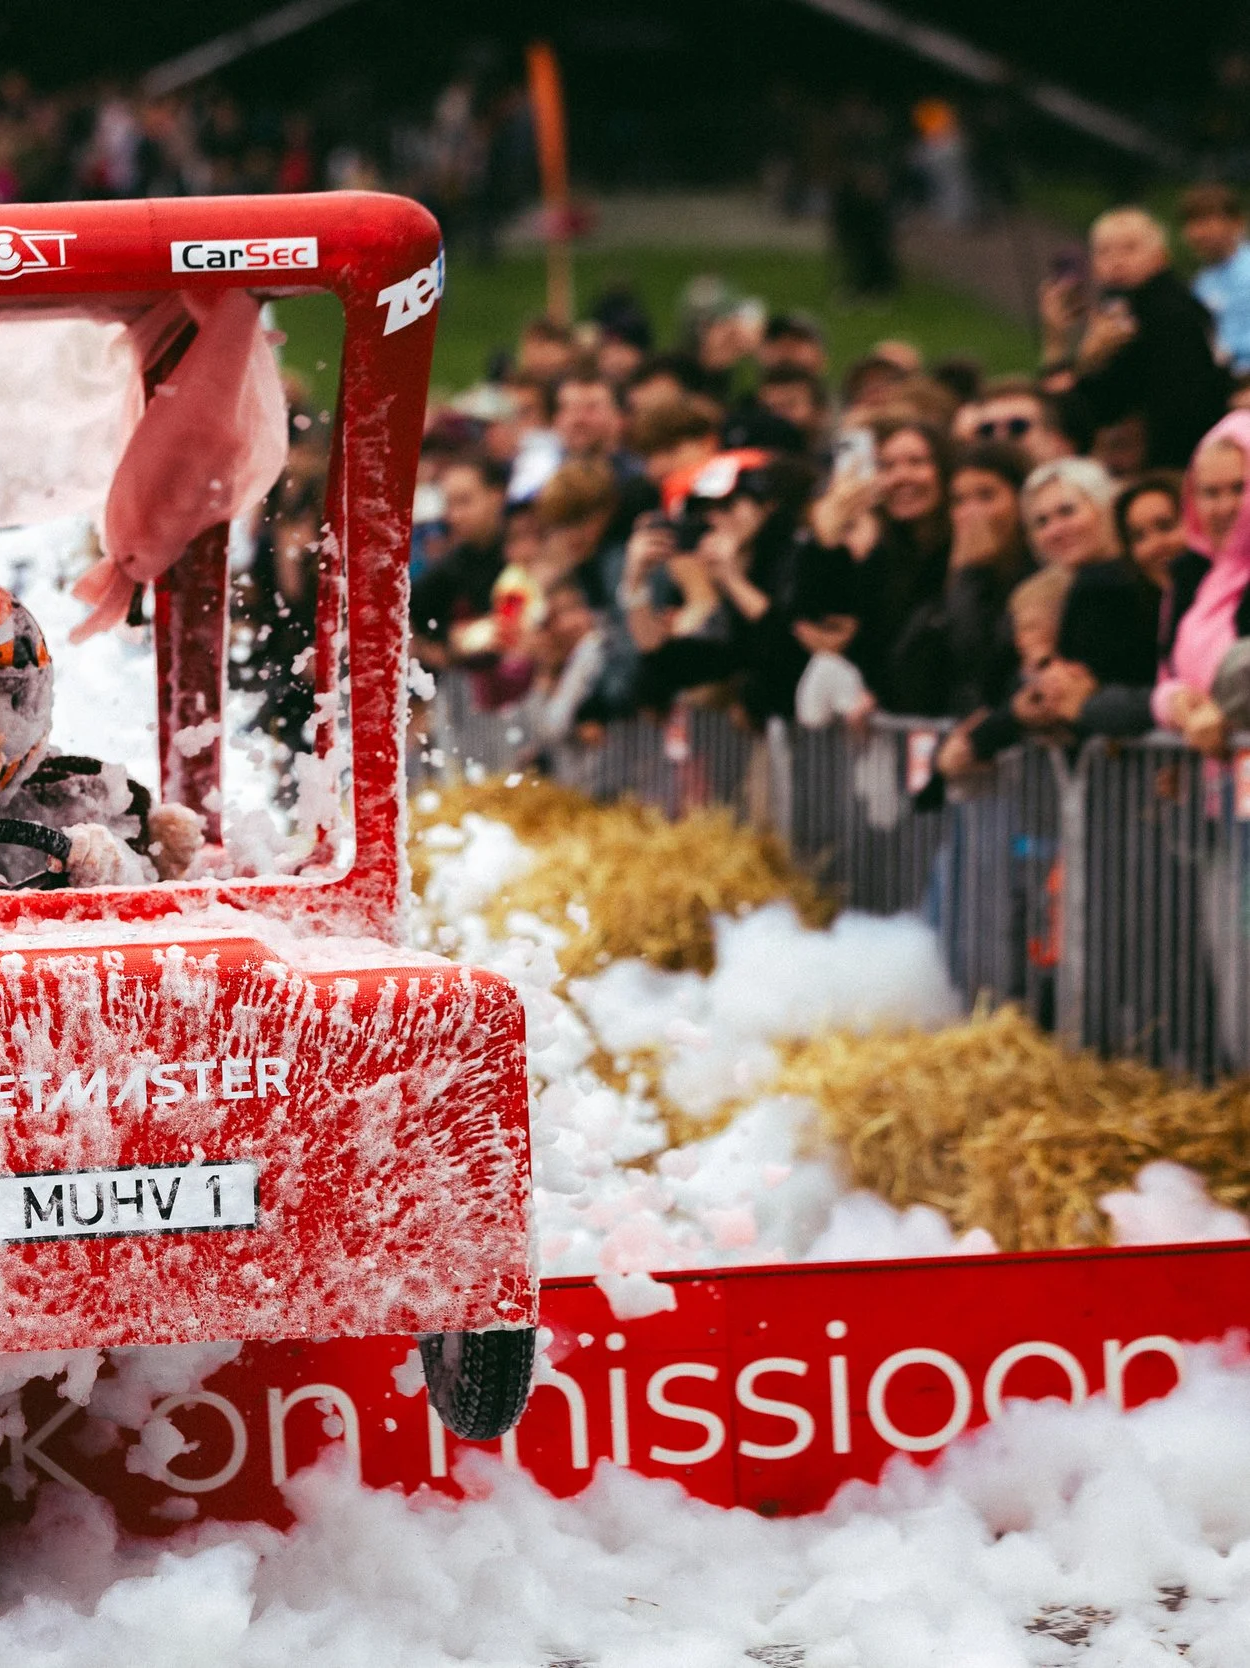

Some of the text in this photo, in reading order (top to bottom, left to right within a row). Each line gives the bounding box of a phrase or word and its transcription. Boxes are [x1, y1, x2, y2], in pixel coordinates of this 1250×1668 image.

[182, 243, 308, 269] CarSec
[23, 1174, 222, 1229] MUHV 1
[142, 1383, 363, 1493] on
